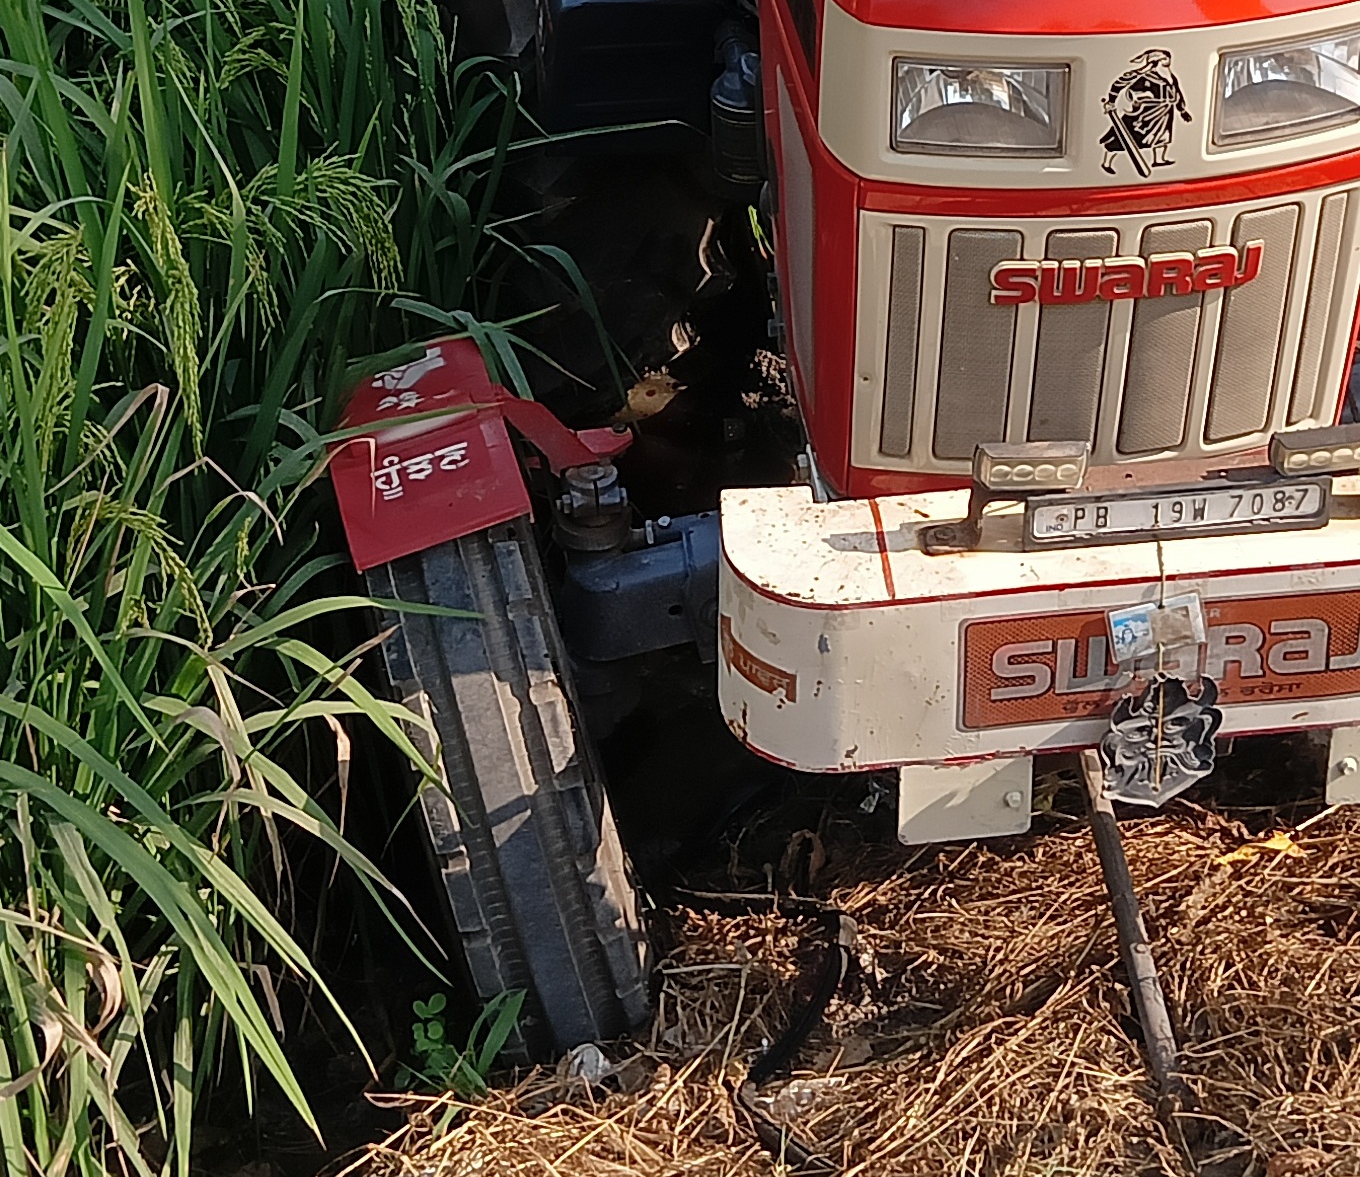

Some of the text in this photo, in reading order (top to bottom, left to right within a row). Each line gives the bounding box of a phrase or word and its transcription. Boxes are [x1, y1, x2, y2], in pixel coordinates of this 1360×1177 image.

[1073, 488, 1310, 530] PB 19W 7087
